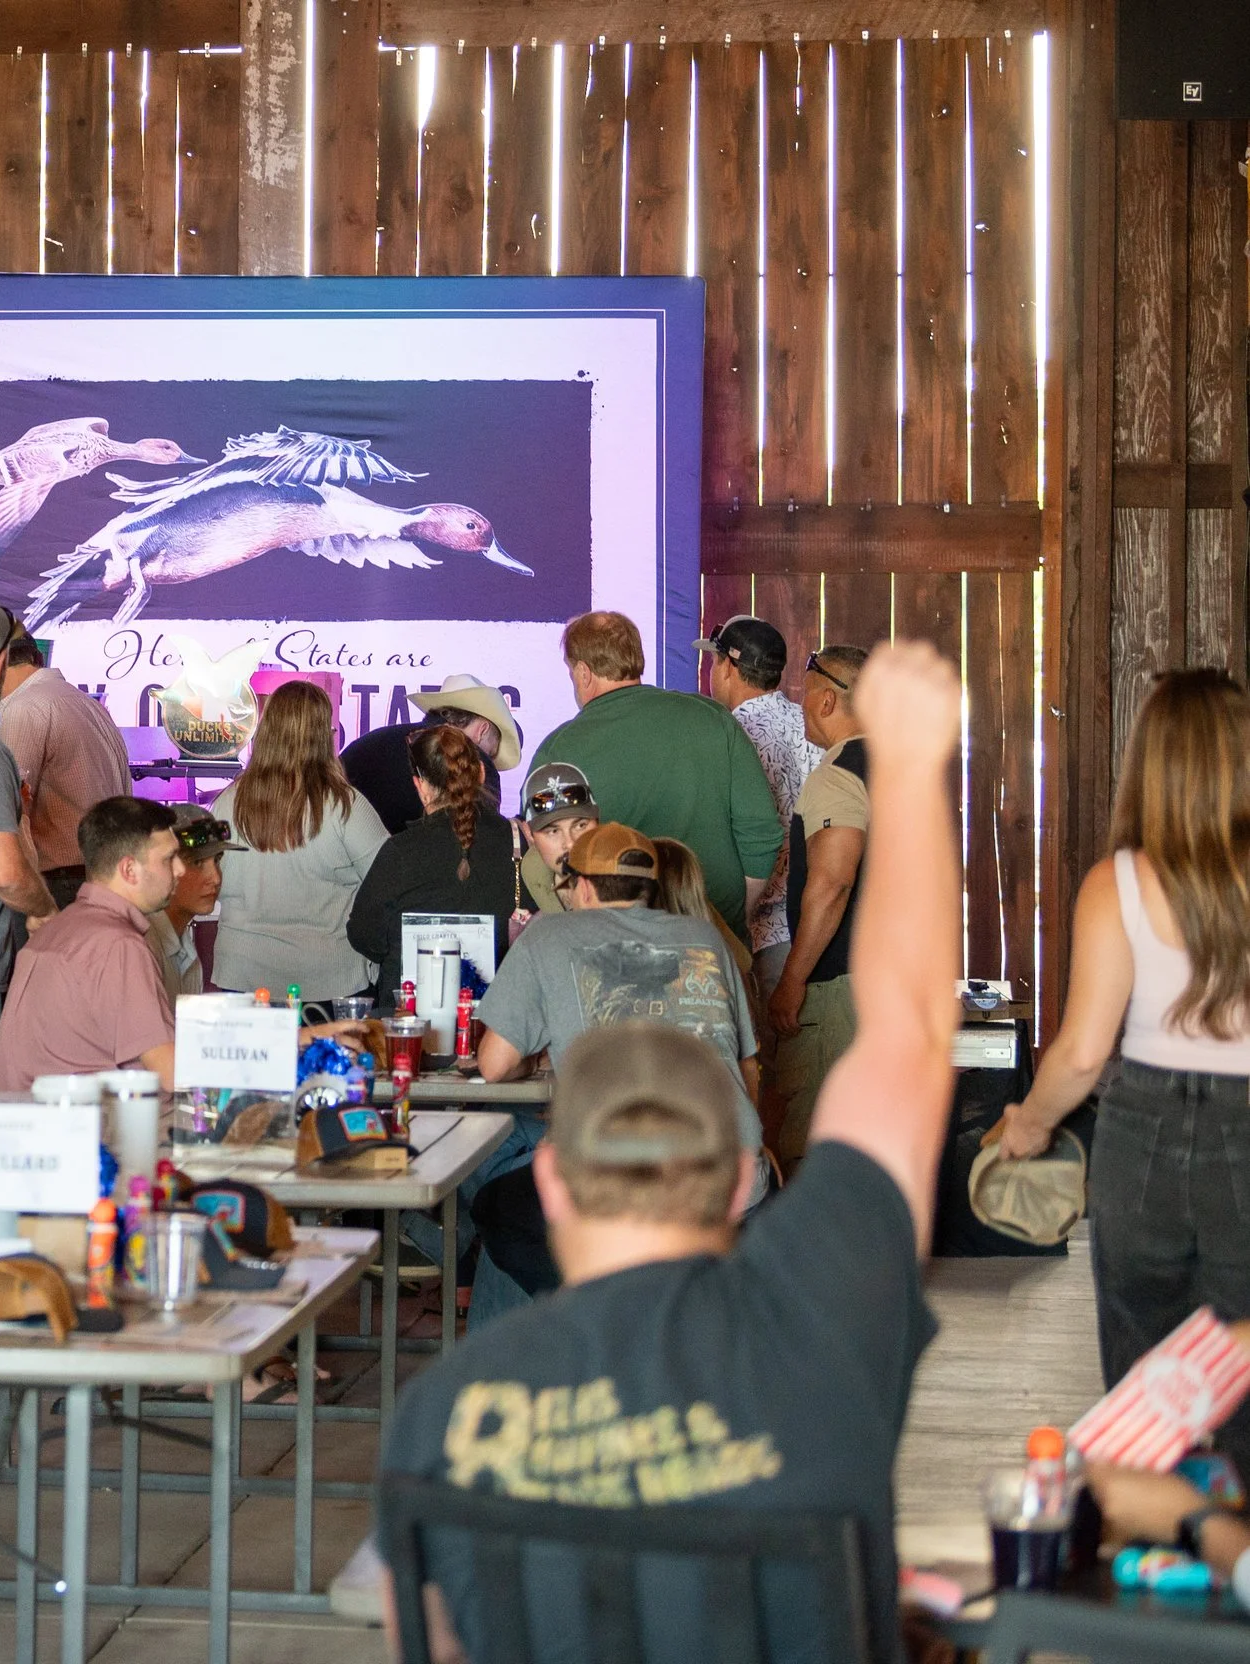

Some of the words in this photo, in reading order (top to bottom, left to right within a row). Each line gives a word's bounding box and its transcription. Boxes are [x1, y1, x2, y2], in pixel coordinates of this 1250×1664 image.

[275, 629, 374, 672] States
[386, 652, 433, 668] are
[188, 721, 231, 732] DUCKS
[174, 730, 244, 744] UNLIMITED
[201, 1046, 269, 1061] SULLIVAN
